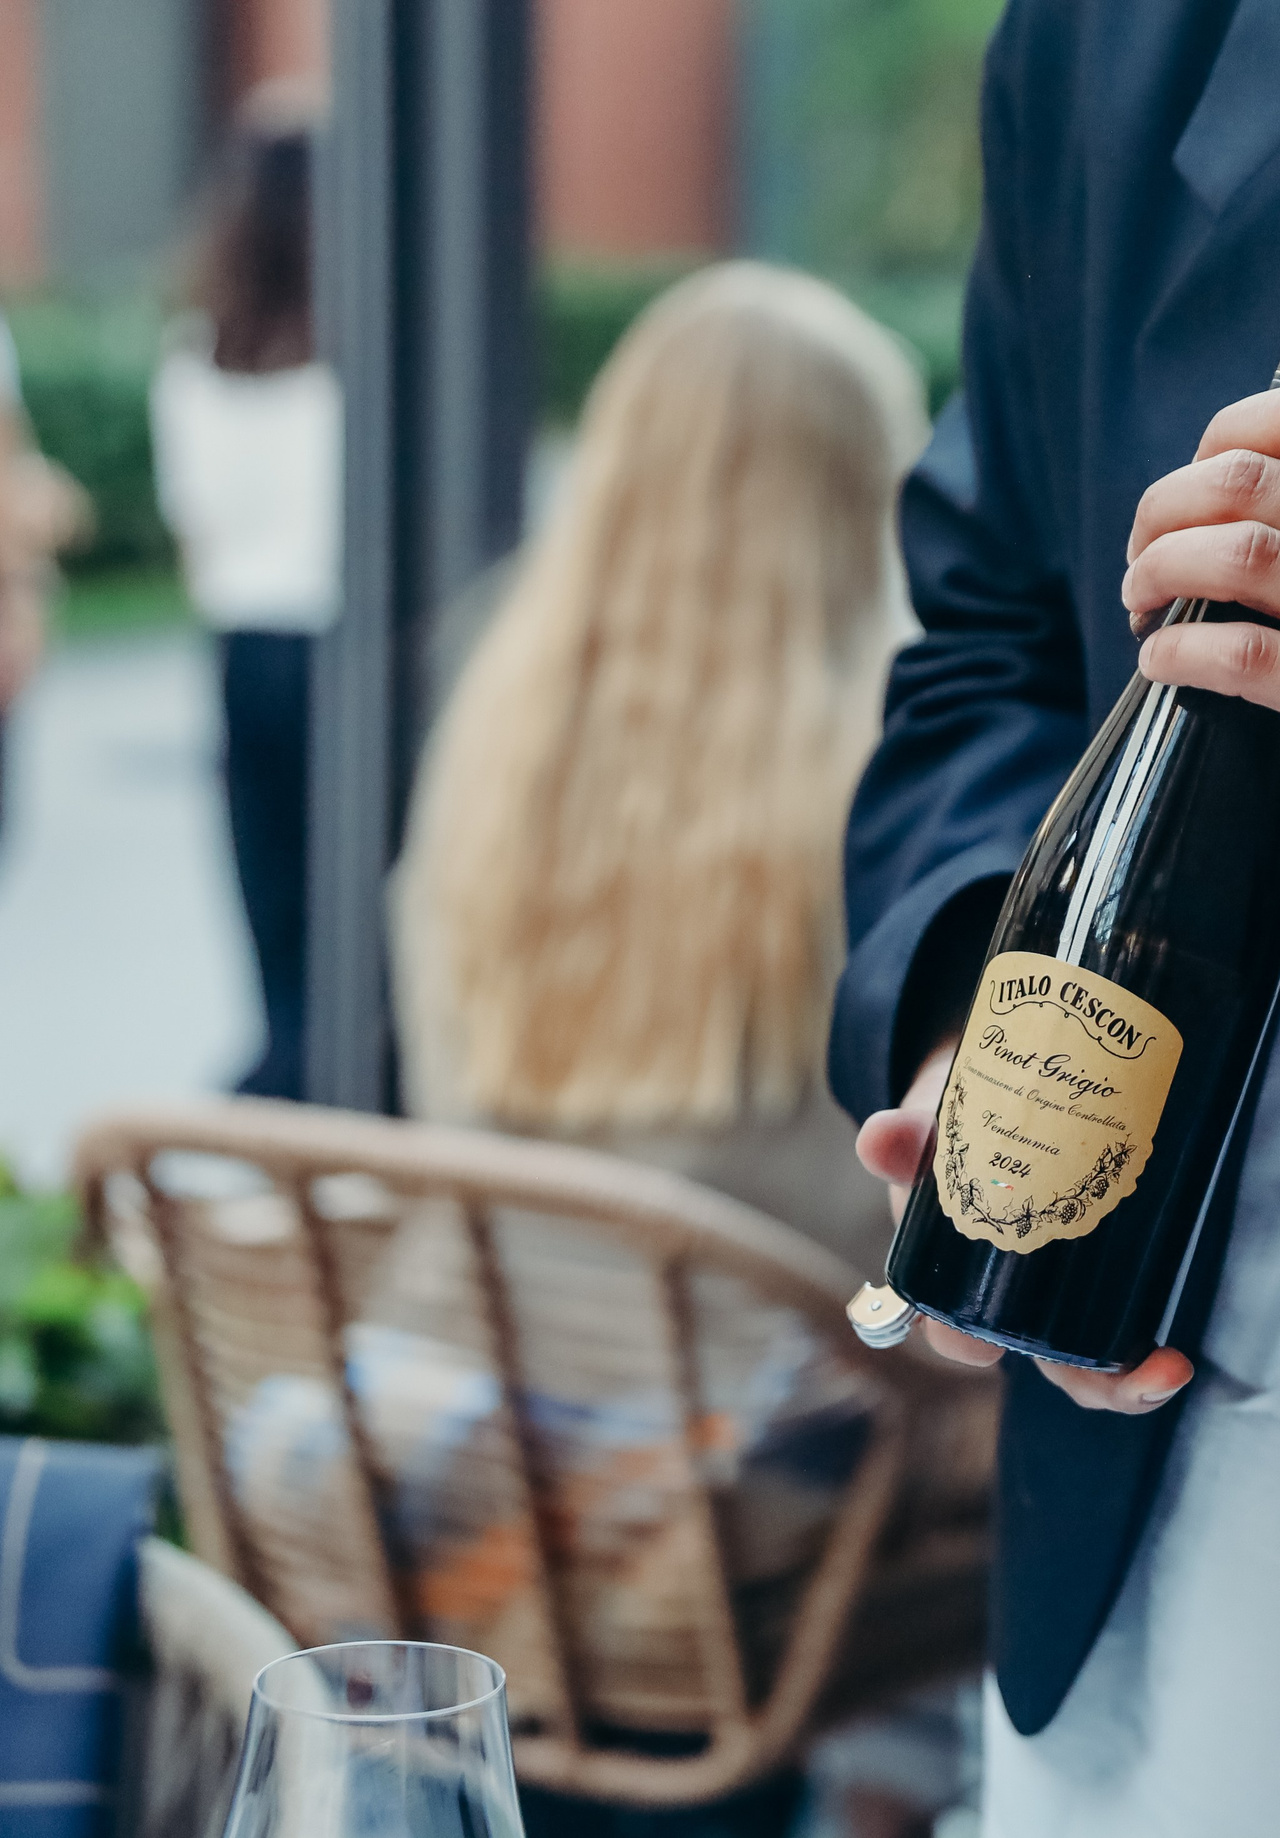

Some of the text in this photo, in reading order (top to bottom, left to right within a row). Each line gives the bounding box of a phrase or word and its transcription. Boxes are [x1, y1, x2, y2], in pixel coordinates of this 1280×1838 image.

[998, 975, 1143, 1050] ITALO CESCON
[979, 1025, 1122, 1100] Pinot Grigio
[1014, 1086, 1025, 1097] di
[1026, 1089, 1065, 1112] Origine
[1068, 1104, 1127, 1132] Controllata
[982, 1110, 1061, 1156] Vendemmia
[988, 1151, 1032, 1179] 2024
